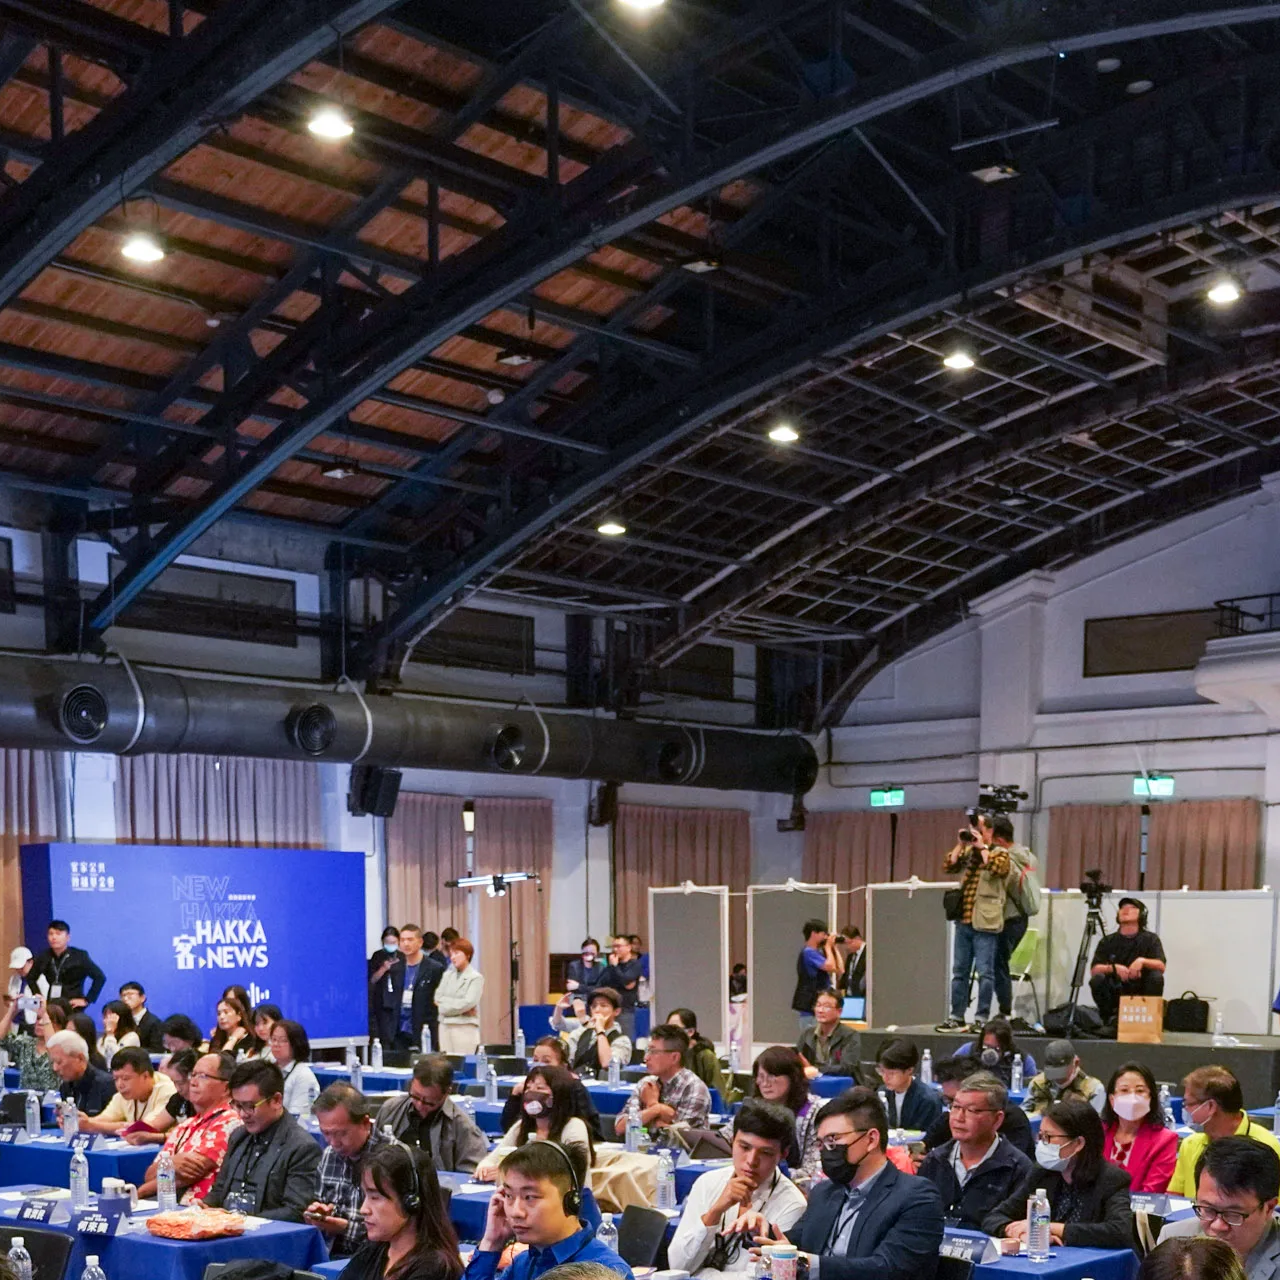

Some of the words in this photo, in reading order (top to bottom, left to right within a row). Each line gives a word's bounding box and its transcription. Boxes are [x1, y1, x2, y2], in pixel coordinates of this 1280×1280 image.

[172, 874, 230, 901] NEW
[196, 920, 267, 944] HAKKA
[206, 945, 269, 969] NEWS
